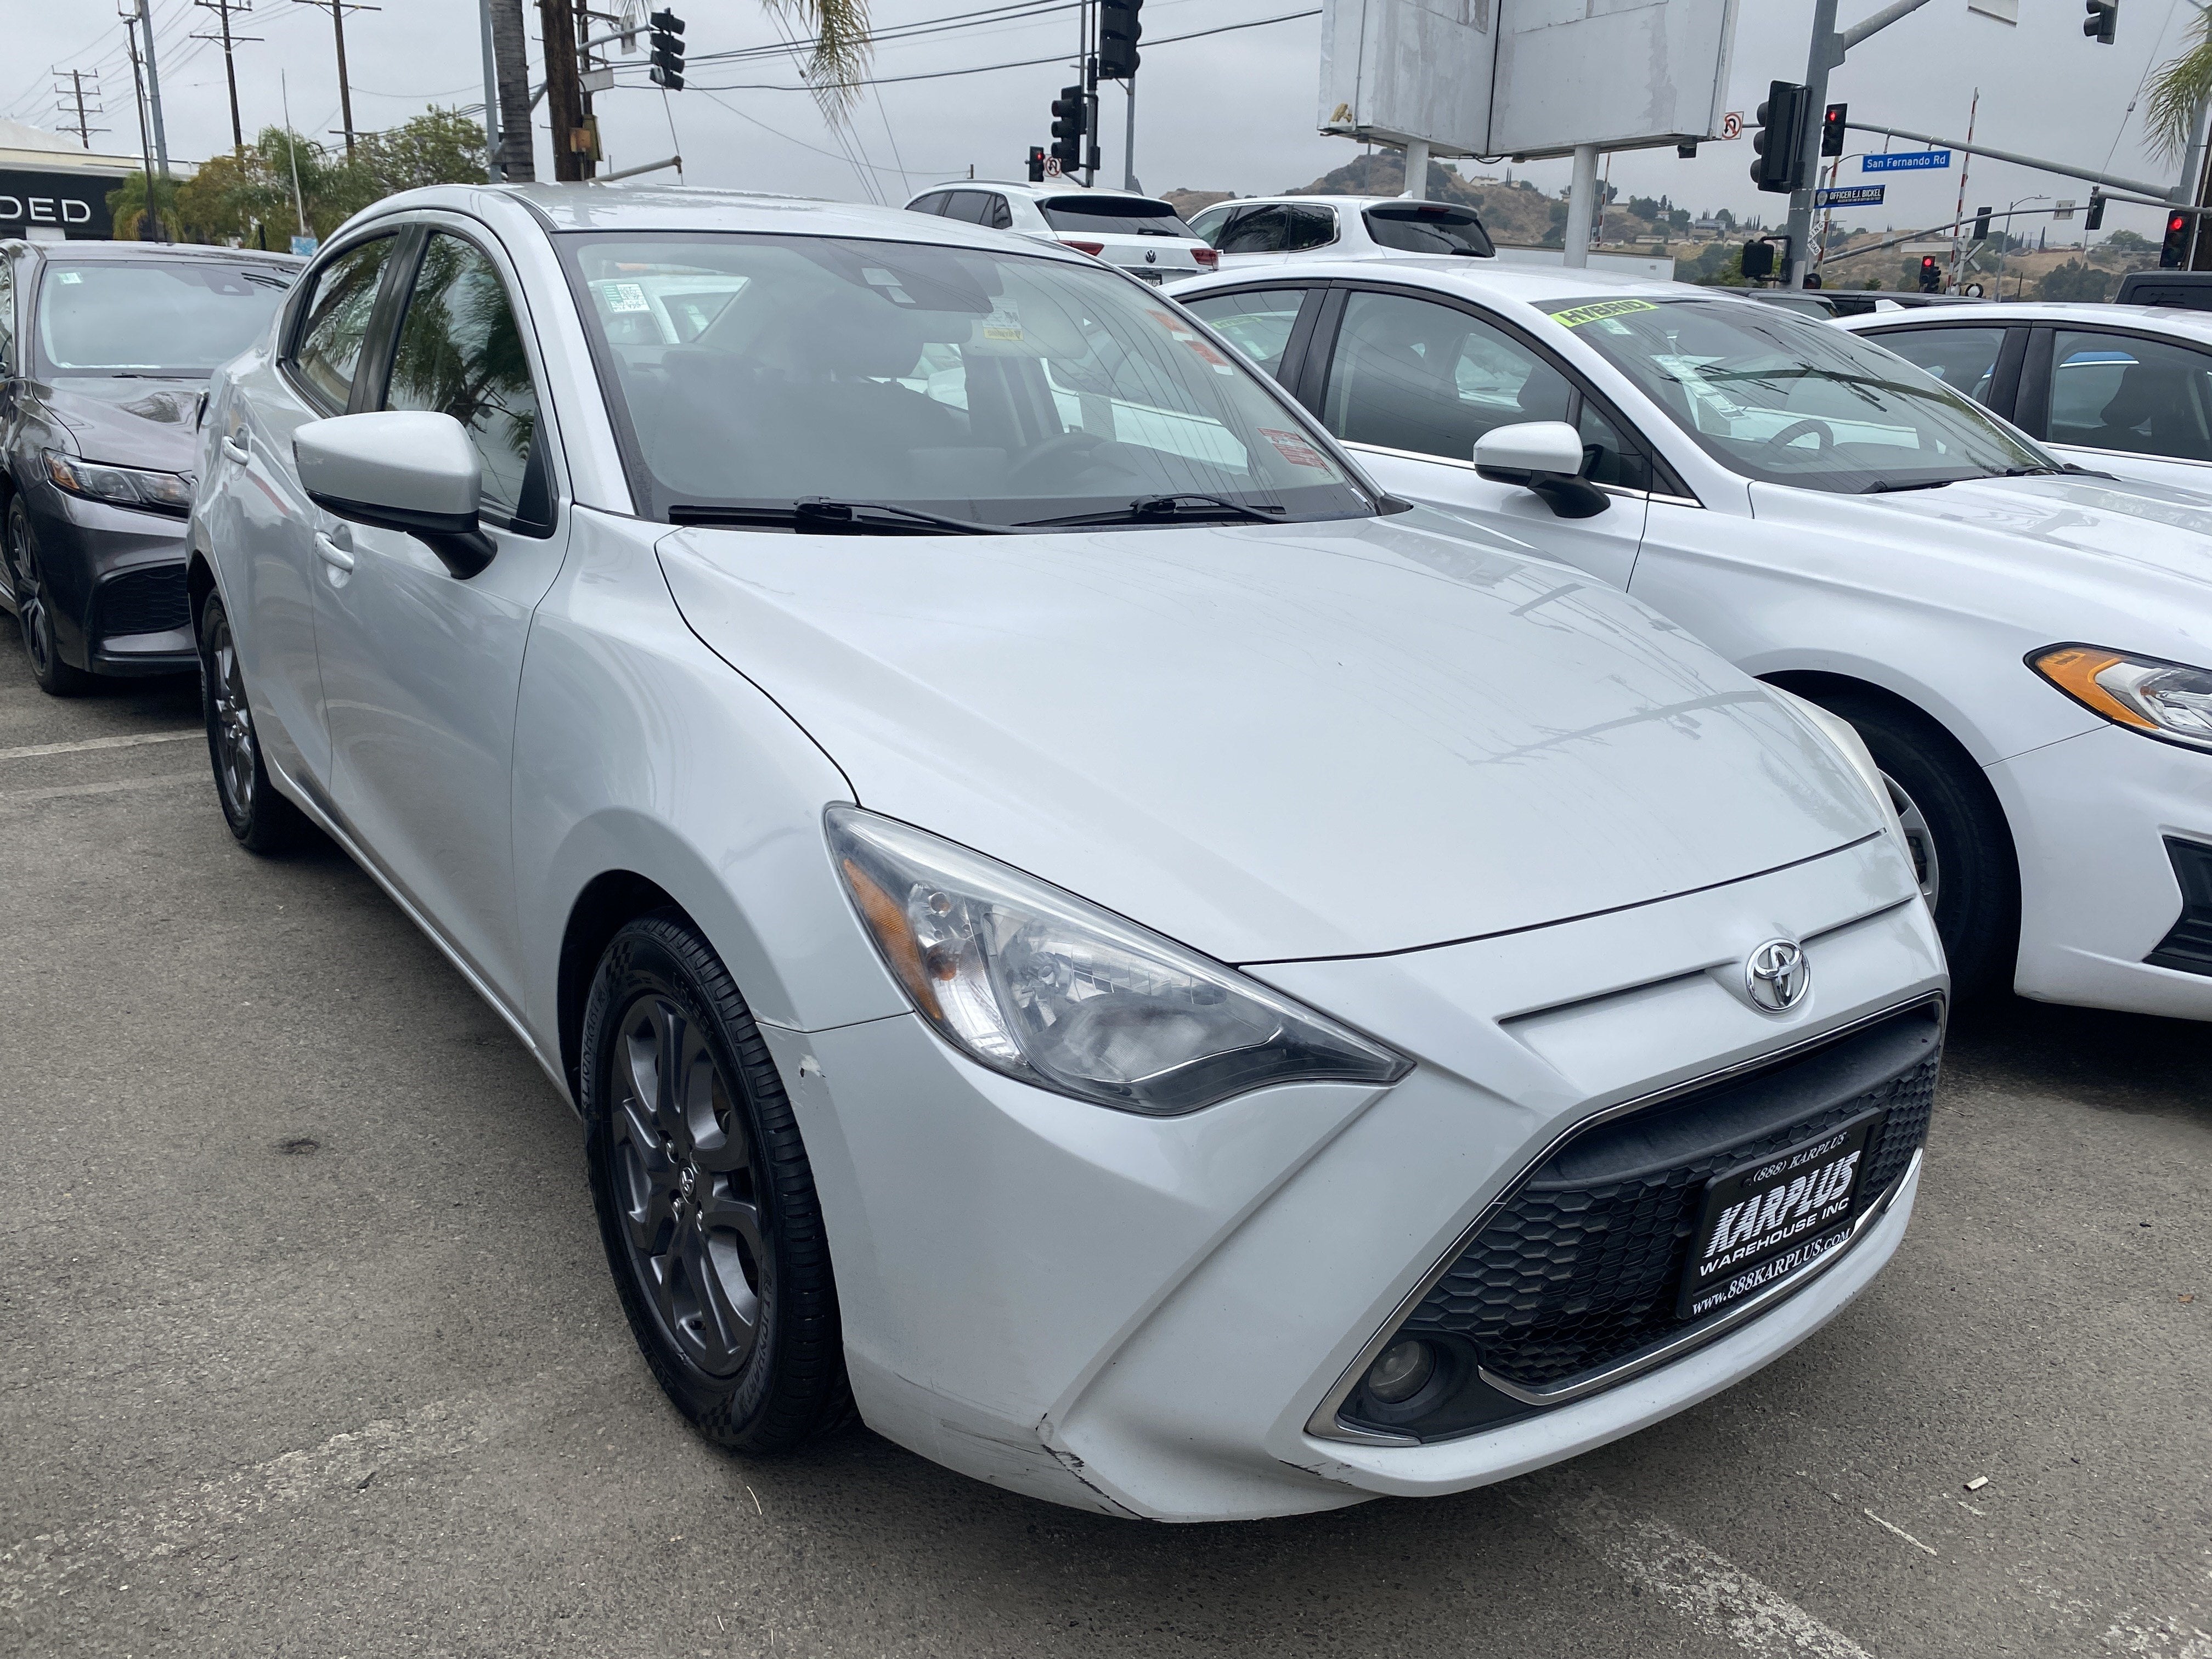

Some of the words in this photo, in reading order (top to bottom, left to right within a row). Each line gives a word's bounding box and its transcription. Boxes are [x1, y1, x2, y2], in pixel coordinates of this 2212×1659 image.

[1867, 159, 1883, 168] San
[1887, 156, 1929, 167] Fernando
[1933, 155, 1945, 165] Rd
[1830, 191, 1851, 200] OFFICER
[1862, 189, 1881, 198] BICKEL
[1559, 301, 1647, 324] HYBRID
[1753, 1160, 1786, 1182] (888)
[1788, 1132, 1847, 1170] KARPLUS
[1702, 1150, 1861, 1259] KARPLUS
[1700, 1215, 1816, 1276] WAREHOUSE
[1822, 1197, 1849, 1220] INC
